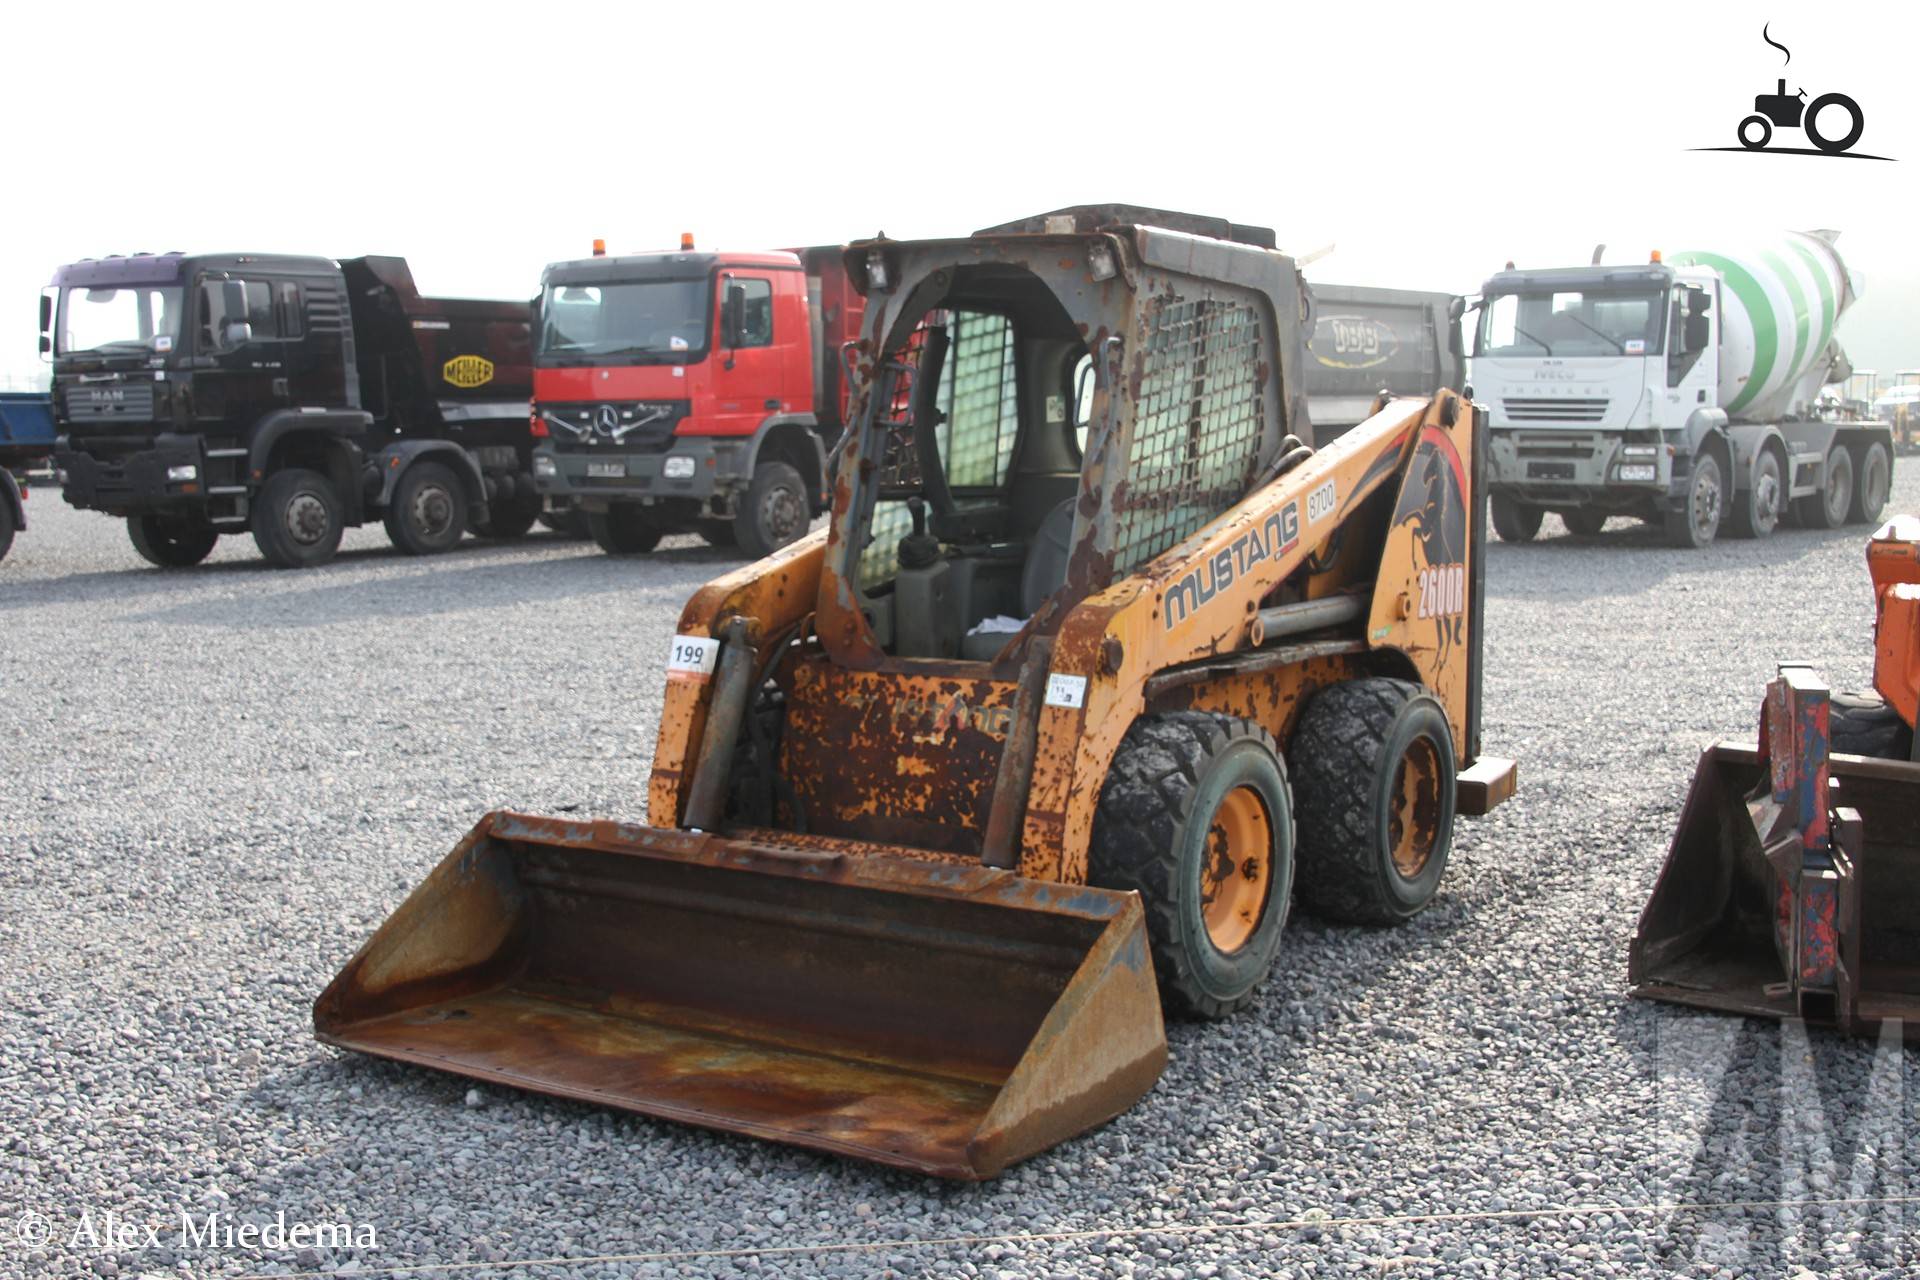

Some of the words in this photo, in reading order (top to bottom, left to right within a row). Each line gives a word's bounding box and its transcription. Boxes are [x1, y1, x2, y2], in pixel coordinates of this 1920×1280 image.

[91, 390, 123, 401] MAN
[1309, 483, 1334, 519] 8700
[1164, 501, 1299, 630] MUSTANG
[675, 644, 704, 664] 199
